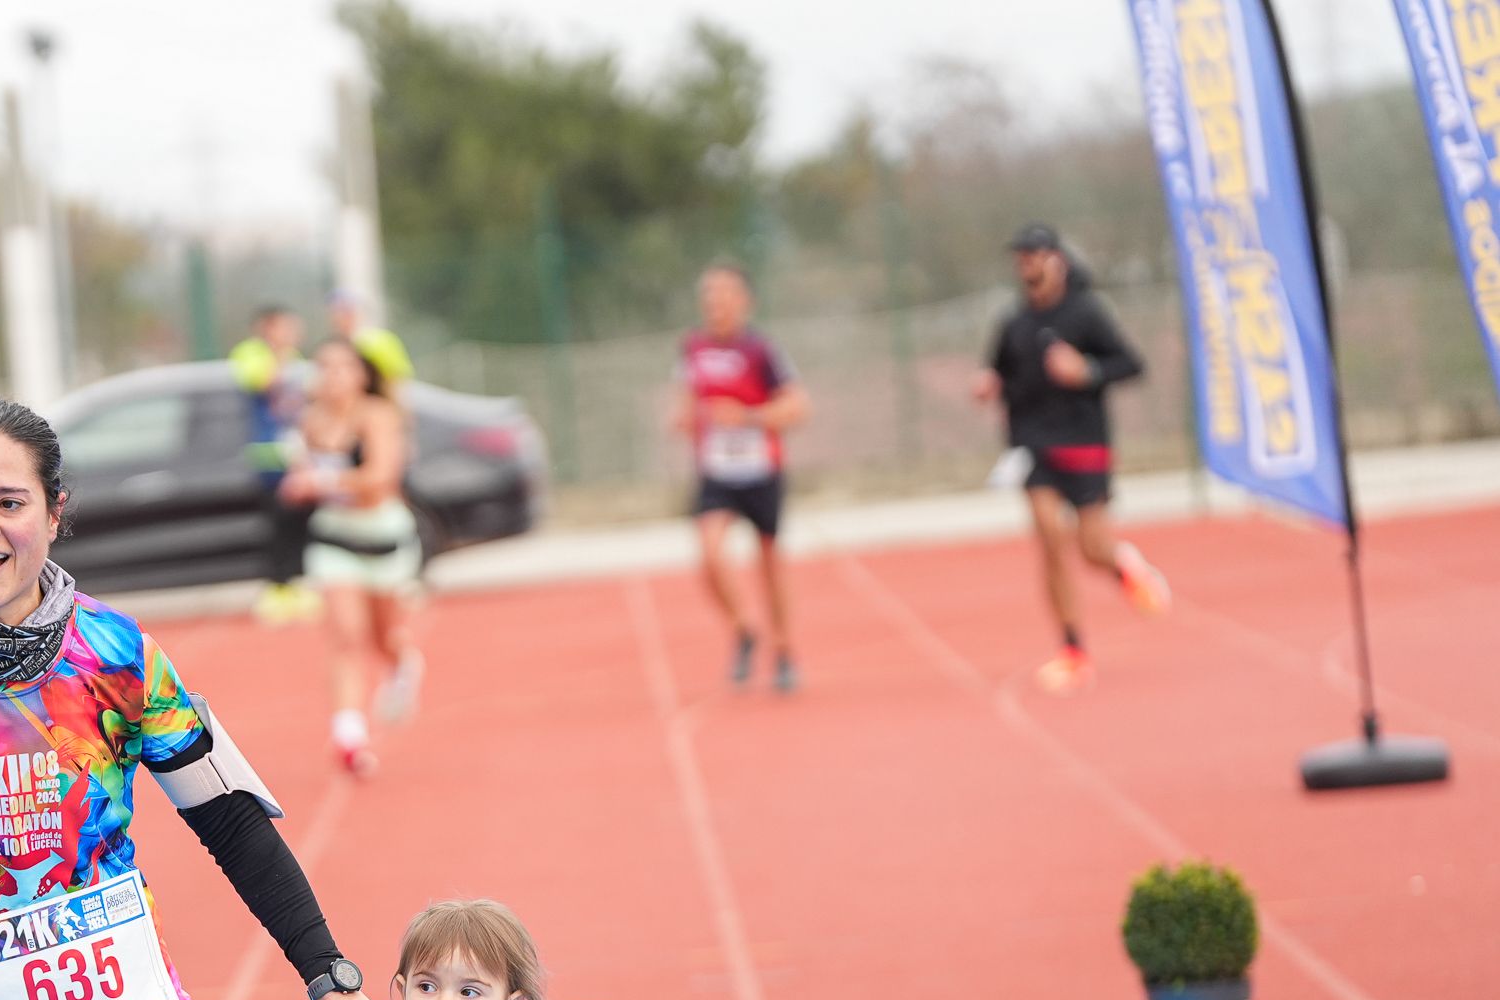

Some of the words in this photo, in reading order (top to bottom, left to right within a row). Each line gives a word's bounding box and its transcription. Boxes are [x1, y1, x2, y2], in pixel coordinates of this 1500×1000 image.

[33, 750, 59, 777] 08
[35, 779, 61, 790] MARZO
[36, 791, 61, 804] 2026
[30, 832, 52, 841] Ciudad
[53, 831, 62, 839] de
[2, 835, 30, 856] 10K
[31, 840, 62, 852] LUCENA
